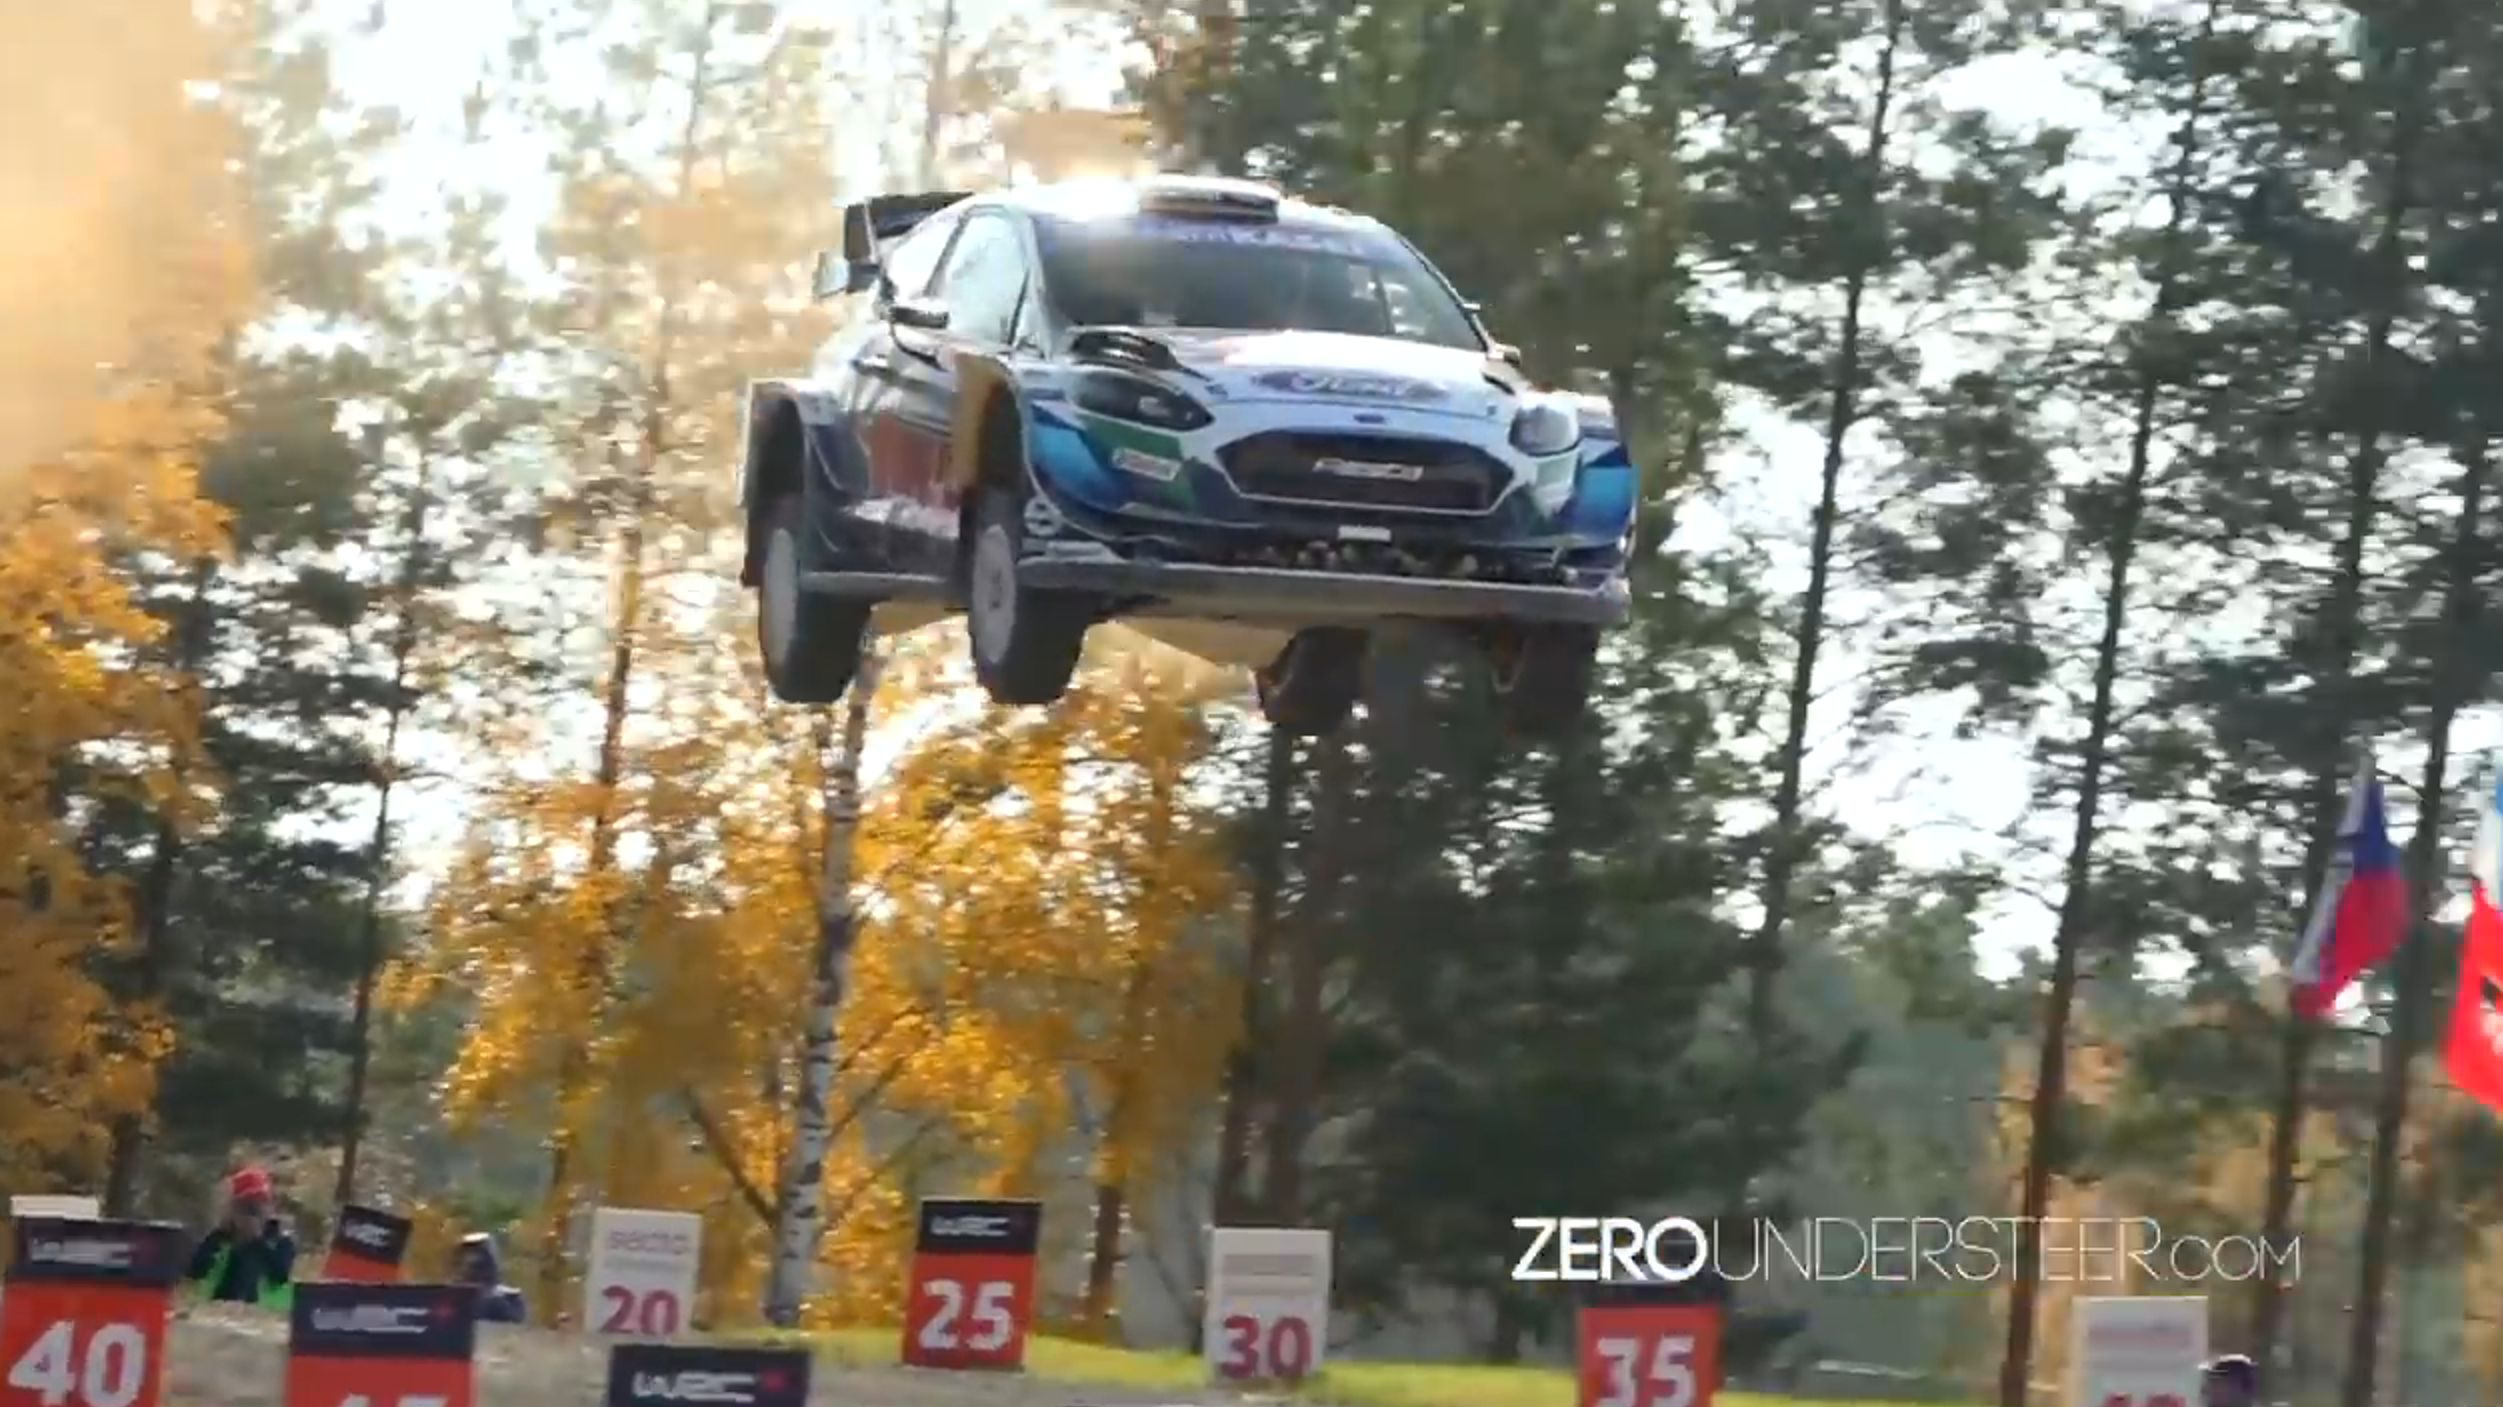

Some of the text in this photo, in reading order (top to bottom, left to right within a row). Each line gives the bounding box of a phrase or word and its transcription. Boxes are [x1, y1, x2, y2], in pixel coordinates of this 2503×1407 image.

[600, 1286, 679, 1337] 20
[919, 1278, 1015, 1350] 25
[1221, 1314, 1312, 1379] 30
[8, 1320, 146, 1407] 40
[1595, 1336, 1697, 1407] 35
